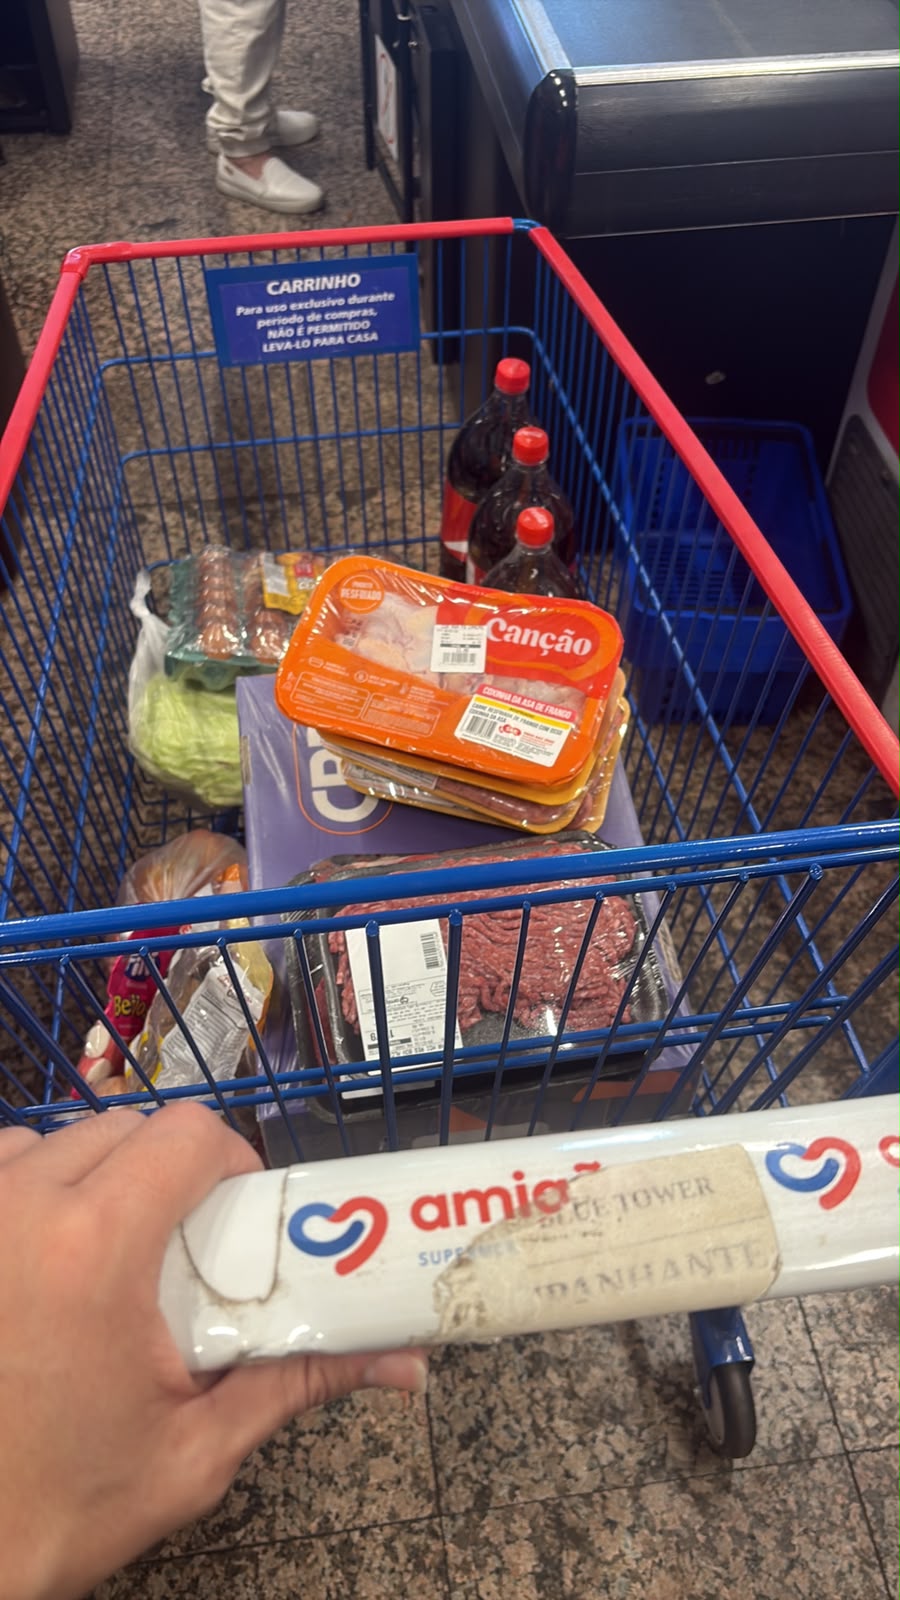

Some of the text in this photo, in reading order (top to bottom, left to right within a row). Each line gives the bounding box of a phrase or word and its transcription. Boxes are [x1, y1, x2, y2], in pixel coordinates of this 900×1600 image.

[266, 273, 361, 296] CARRINHO
[236, 291, 396, 317] Para uso exclusivo durante
[306, 311, 323, 322] de
[325, 308, 378, 323] compras,
[262, 331, 379, 353] LEVA-LO PARA CASA
[267, 320, 371, 340] NÃO É PERMITIDO
[486, 616, 592, 658] Canção
[483, 687, 511, 702] COXINHA
[512, 694, 521, 704] DA
[521, 697, 535, 709] ASA
[536, 701, 544, 712] DE
[545, 704, 572, 719] FRANGO
[614, 1176, 715, 1214] TOWER
